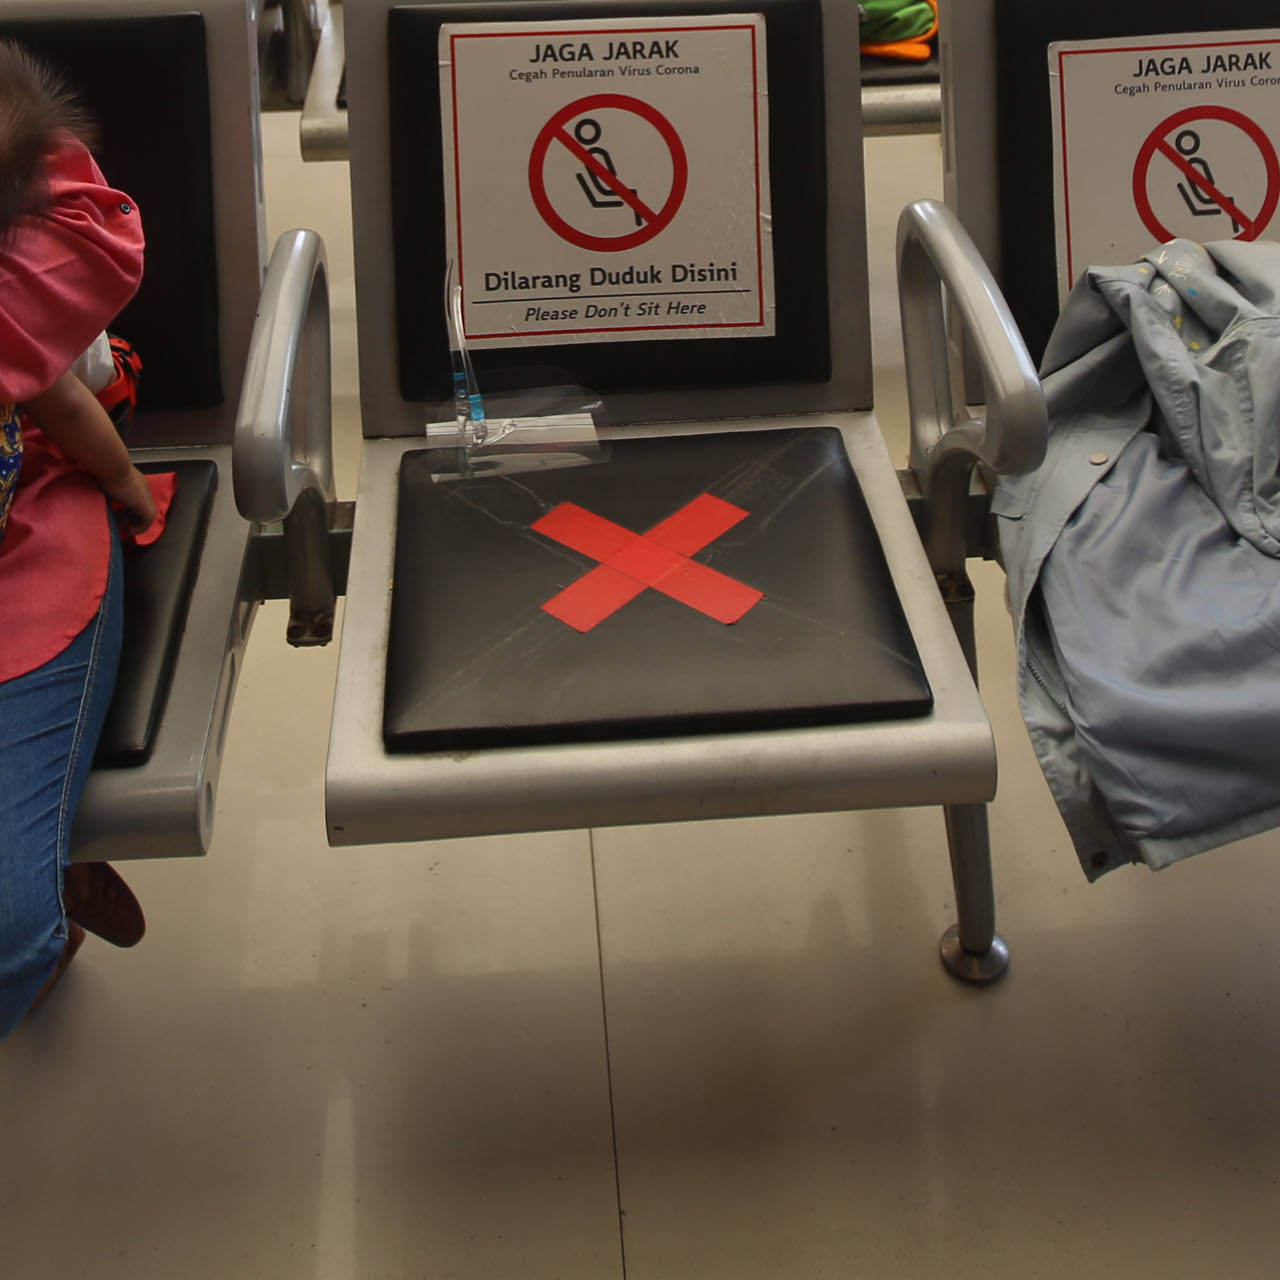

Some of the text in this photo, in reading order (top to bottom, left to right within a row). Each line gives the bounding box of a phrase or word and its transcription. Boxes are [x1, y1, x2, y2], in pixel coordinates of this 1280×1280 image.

[530, 40, 679, 63] JAGA JARAK
[509, 65, 700, 83] Cegah Penularan Virus Corona
[1133, 52, 1271, 77] JAGA JARAK
[1114, 83, 1149, 96] Cegah
[1154, 80, 1211, 92] Penularan
[1217, 78, 1246, 88] Virus
[485, 262, 737, 293] Dilarang Duduk Disini
[525, 301, 706, 321] Please Don't Sit Here
